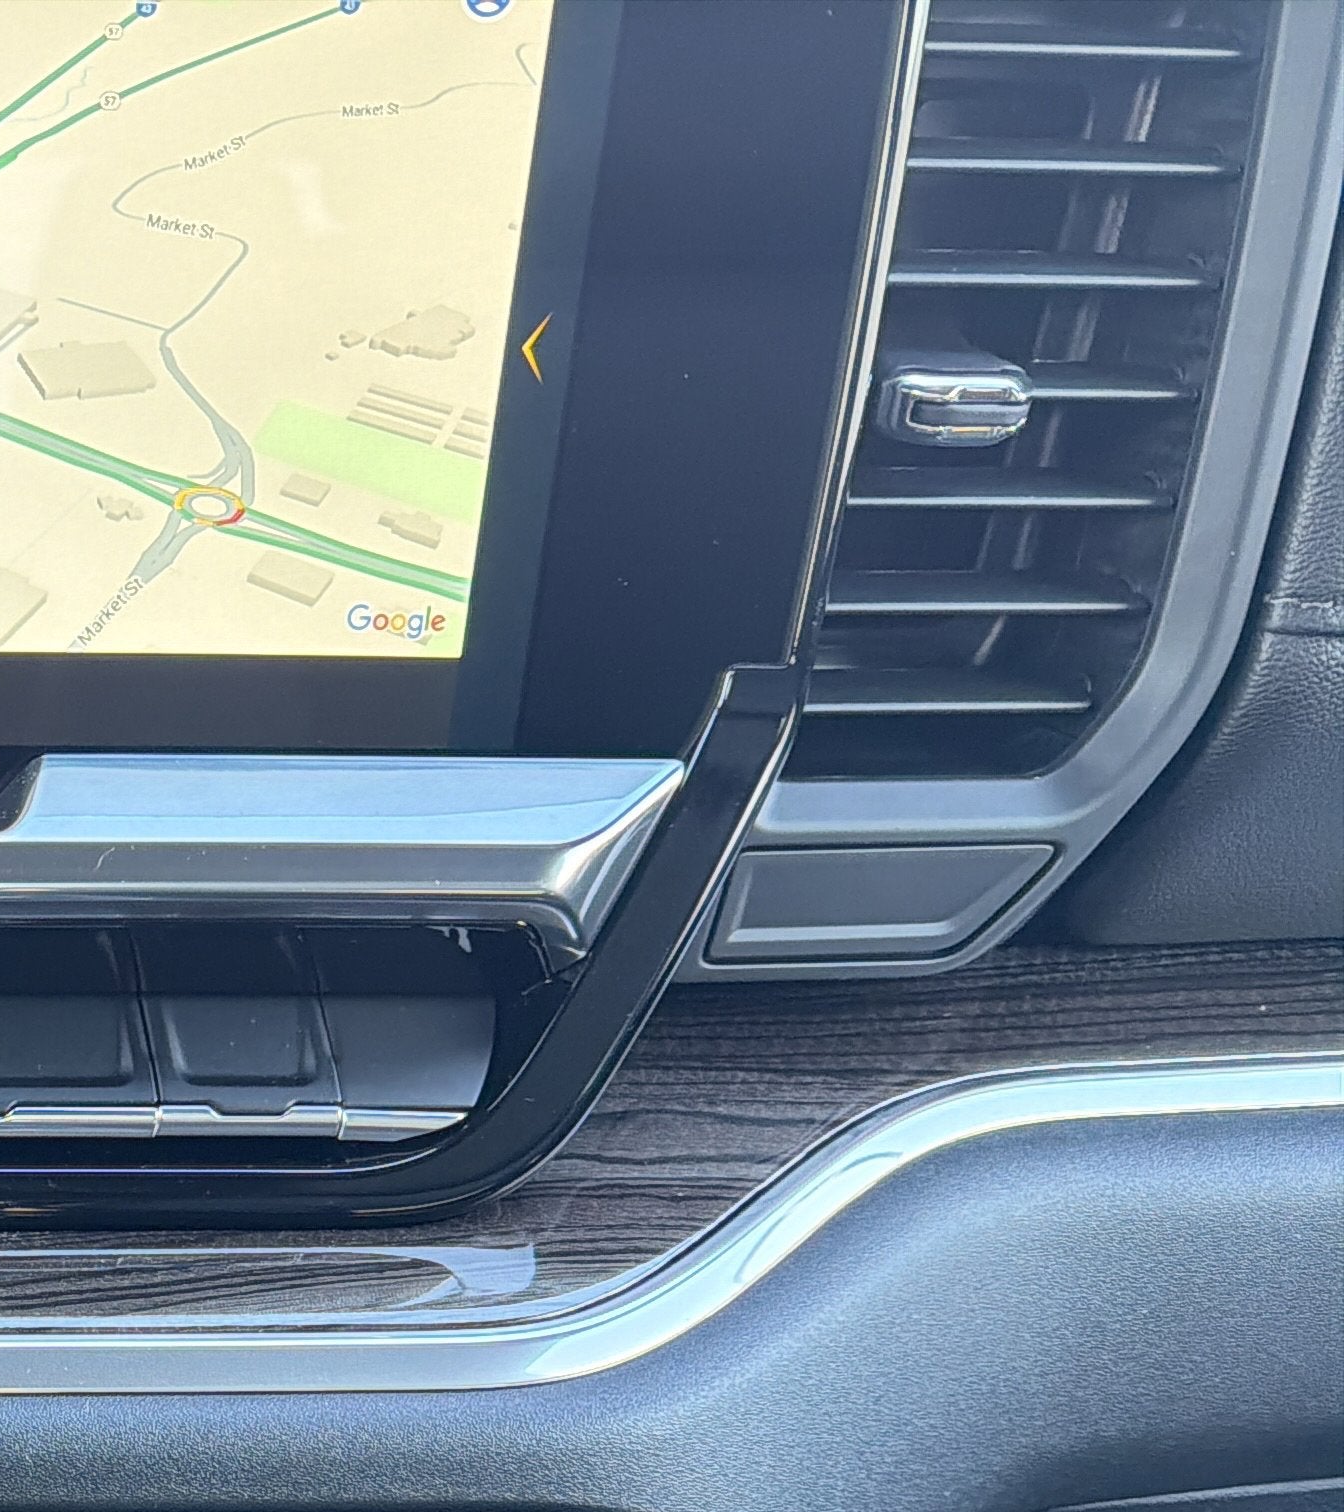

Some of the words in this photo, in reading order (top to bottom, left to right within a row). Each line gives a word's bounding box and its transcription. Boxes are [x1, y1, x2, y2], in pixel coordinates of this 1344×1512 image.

[104, 95, 117, 106] 57
[342, 103, 383, 117] Market
[386, 103, 400, 116] St
[183, 142, 229, 171] Market
[229, 136, 246, 153] St
[146, 213, 198, 236] Market
[198, 222, 215, 240] St
[78, 596, 126, 645] Market
[123, 577, 143, 601] St
[347, 603, 447, 638] Google
